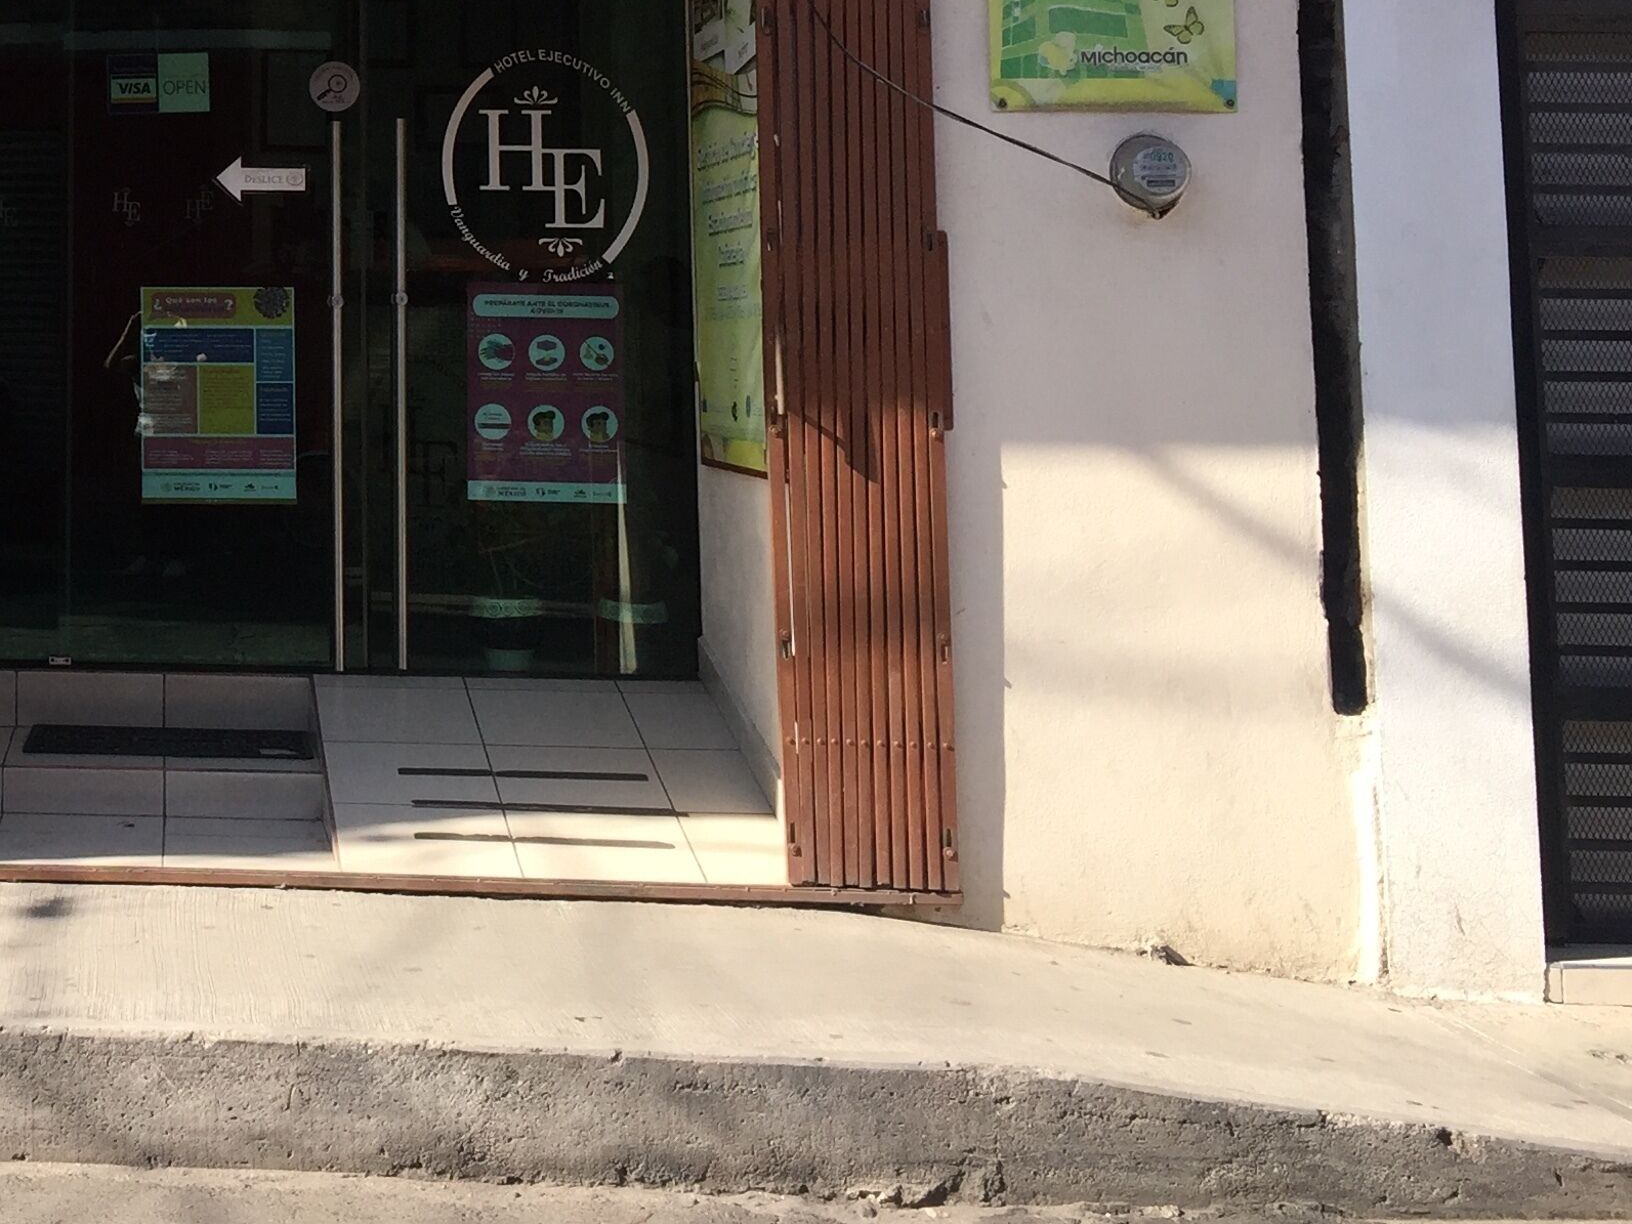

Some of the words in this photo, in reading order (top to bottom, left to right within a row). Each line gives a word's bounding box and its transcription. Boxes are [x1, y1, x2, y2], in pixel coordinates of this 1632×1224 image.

[1080, 43, 1189, 67] Michoacán
[117, 81, 152, 95] VISA
[163, 79, 207, 96] OPEN
[493, 49, 536, 73] HOTEL
[537, 49, 611, 89] EJECUTIVO
[610, 87, 632, 113] INN
[449, 206, 511, 271] Vanguardia
[518, 267, 529, 282] y
[542, 260, 604, 284] Tradición
